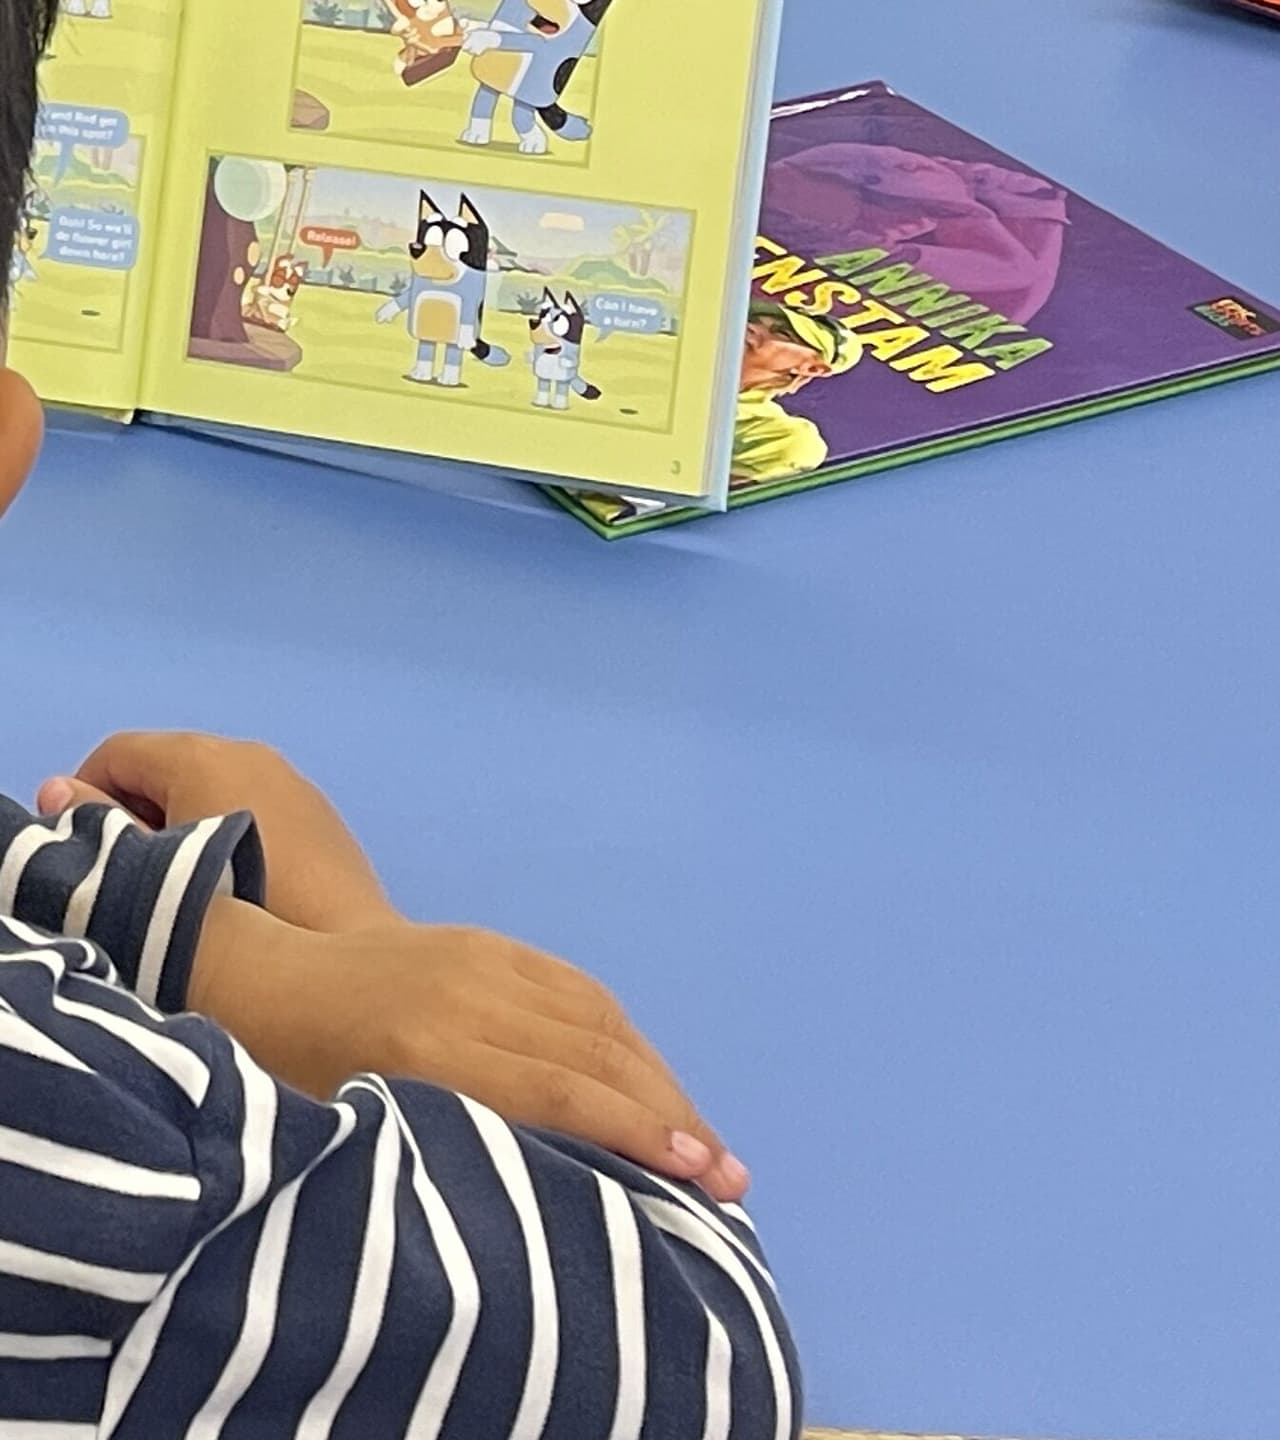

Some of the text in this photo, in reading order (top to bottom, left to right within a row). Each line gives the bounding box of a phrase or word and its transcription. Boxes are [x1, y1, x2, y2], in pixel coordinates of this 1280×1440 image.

[596, 297, 619, 311] Can
[628, 303, 659, 317] have
[814, 248, 1053, 371] ANNIKA
[603, 317, 612, 326] a
[670, 459, 682, 475] 3
